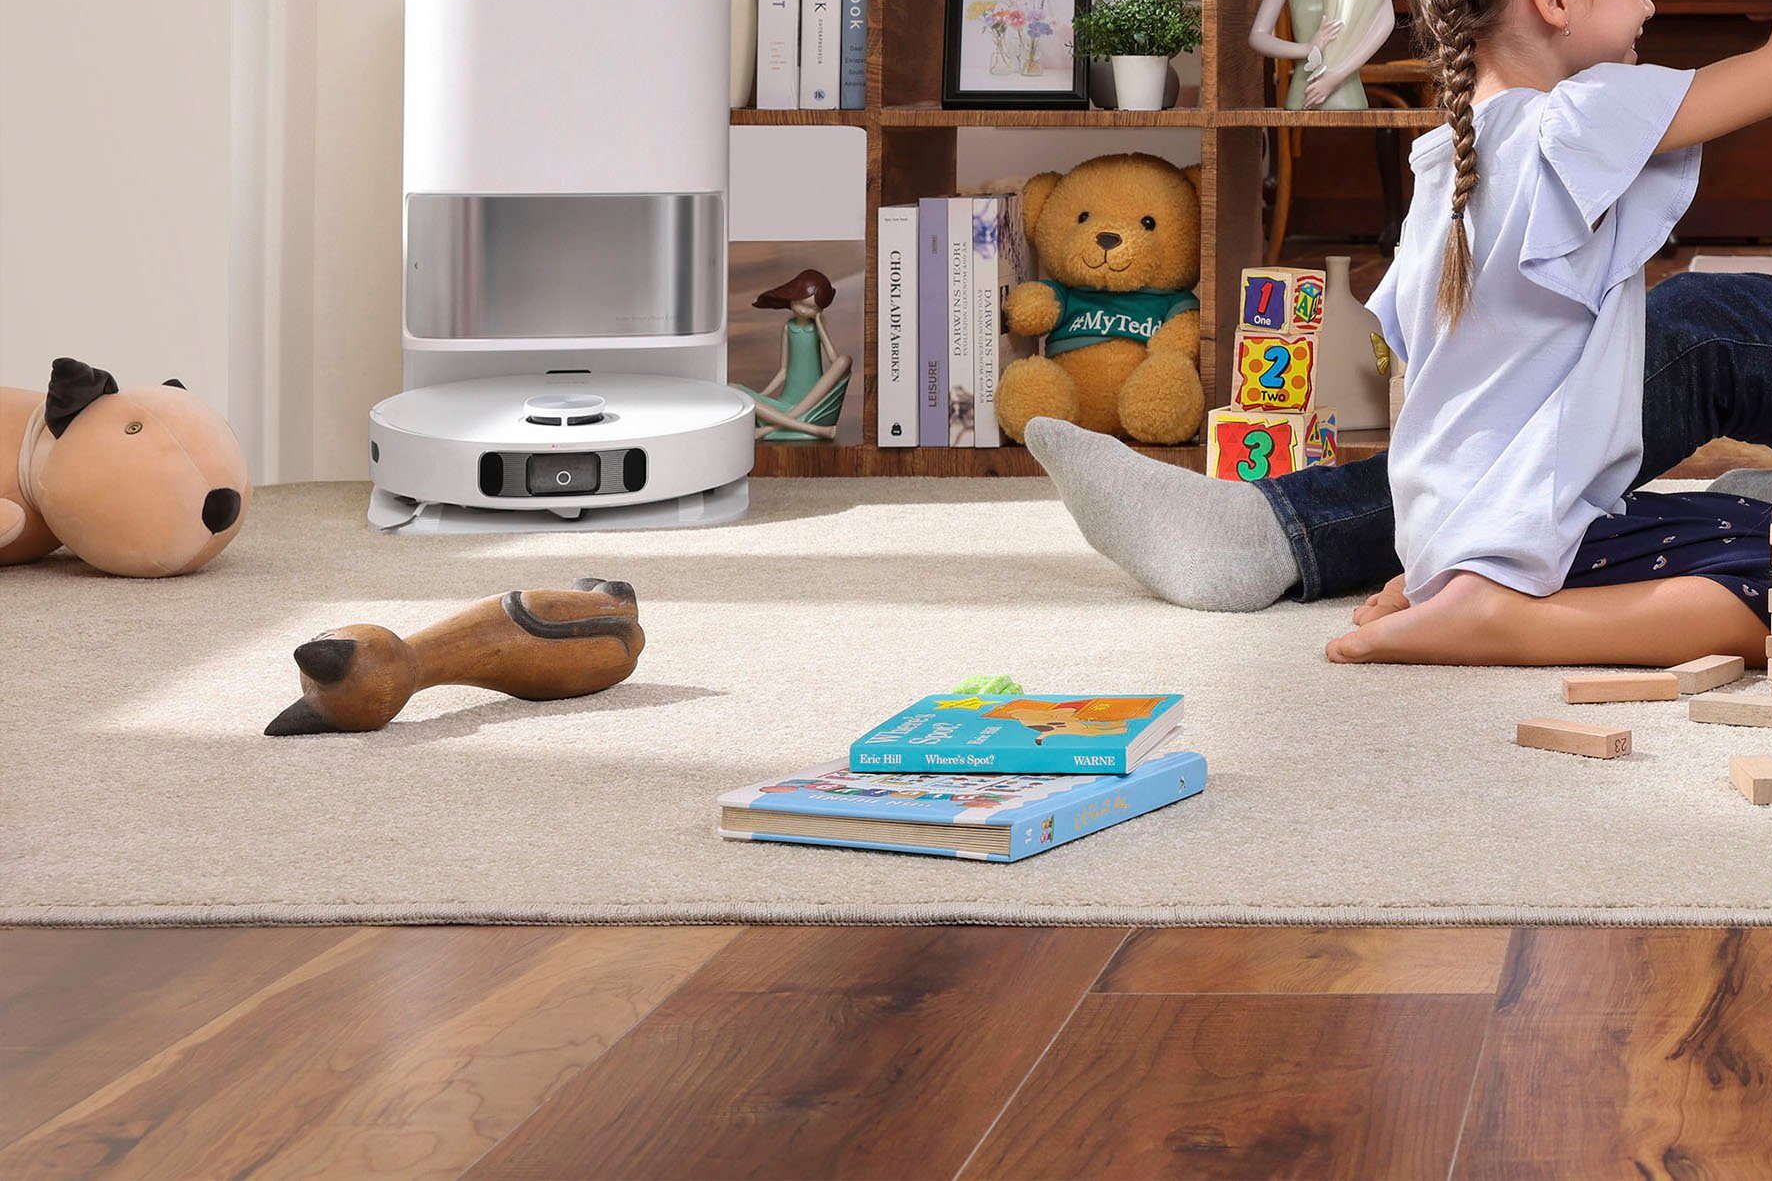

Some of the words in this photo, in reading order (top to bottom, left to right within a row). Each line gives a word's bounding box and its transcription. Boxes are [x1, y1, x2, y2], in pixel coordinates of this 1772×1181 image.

[953, 242, 961, 286] TEORI
[890, 250, 901, 383] CHOKLADFABRIKEN
[1257, 281, 1274, 315] 1
[953, 290, 962, 356] DARWINS
[984, 289, 993, 356] DARWINS
[1068, 310, 1163, 337] #MyTedd
[1253, 315, 1272, 326] One
[928, 360, 937, 408] LEISURE
[984, 360, 993, 404] TEORI
[1259, 346, 1291, 390] 2
[1260, 390, 1286, 402] Two
[1237, 428, 1275, 482] 3
[859, 754, 881, 764] Eric
[883, 754, 902, 764] Hill
[925, 754, 965, 765] Where's
[967, 754, 995, 766] Spot?
[1074, 755, 1116, 766] WARNE
[1614, 737, 1627, 753] 23
